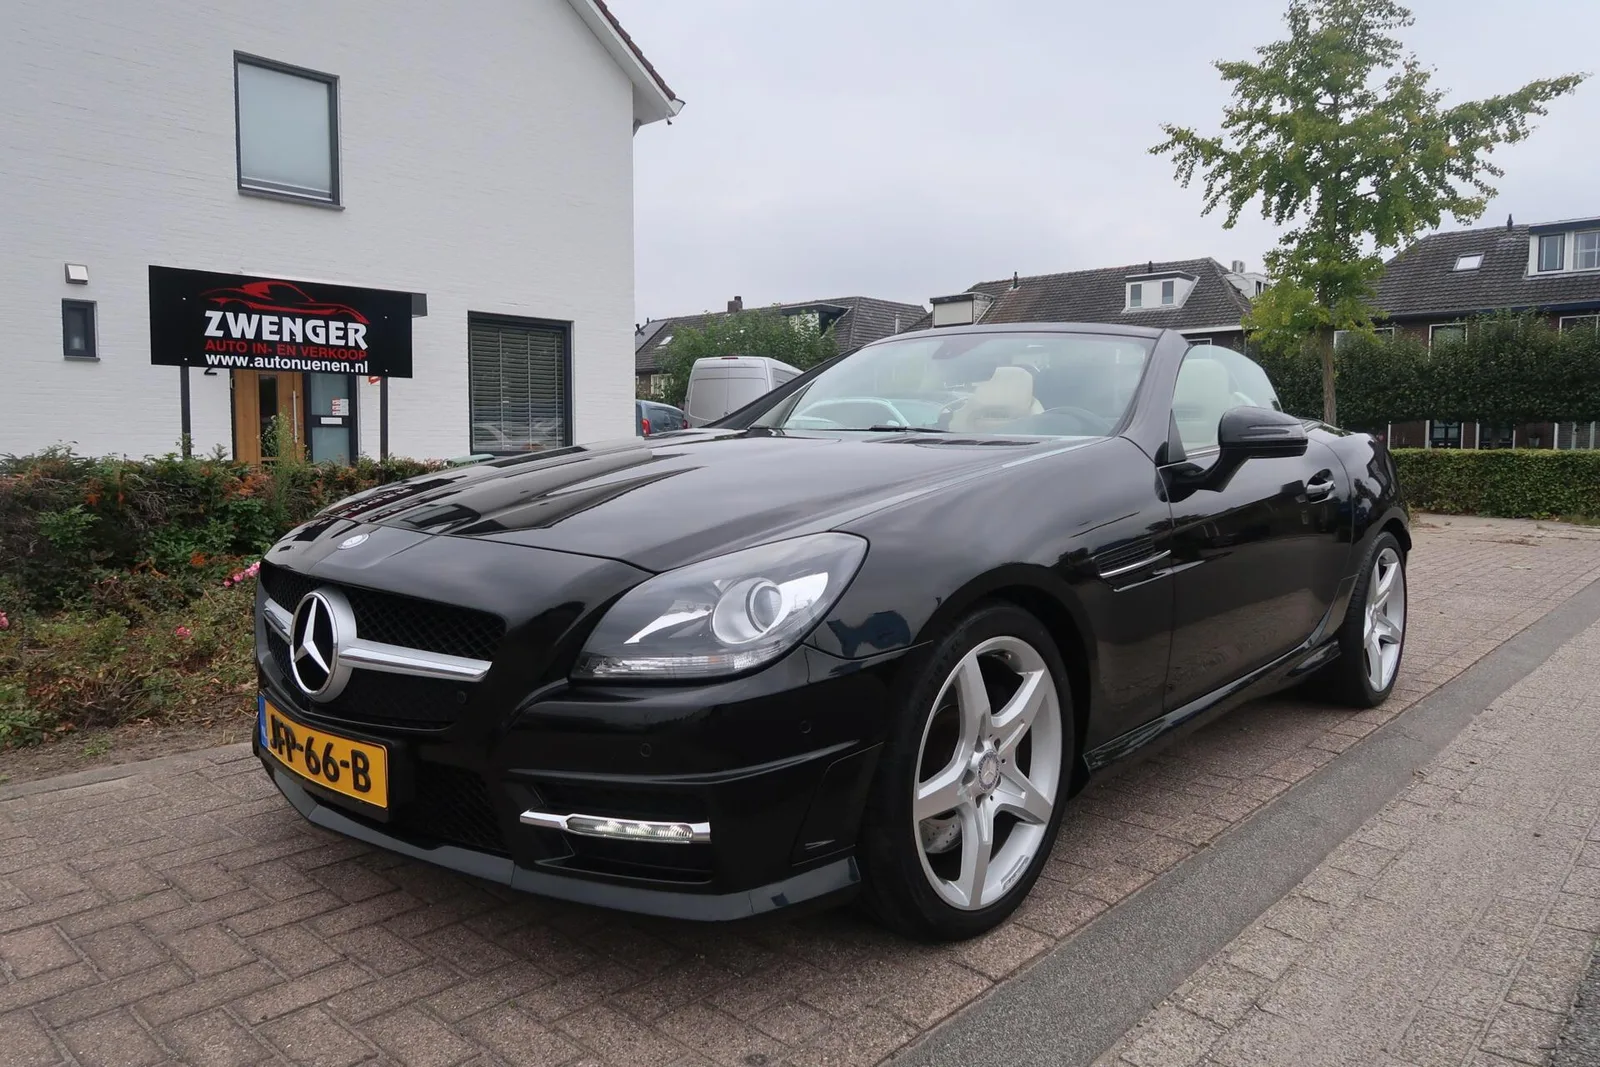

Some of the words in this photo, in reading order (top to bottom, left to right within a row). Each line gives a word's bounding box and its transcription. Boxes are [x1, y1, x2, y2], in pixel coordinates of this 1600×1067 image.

[204, 310, 368, 350] ZWENGER
[205, 339, 247, 353] AUTO
[253, 342, 273, 354] IN-
[277, 344, 297, 356] EN
[300, 345, 368, 360] VERKOOP
[205, 353, 369, 373] www.autonuenen.nl
